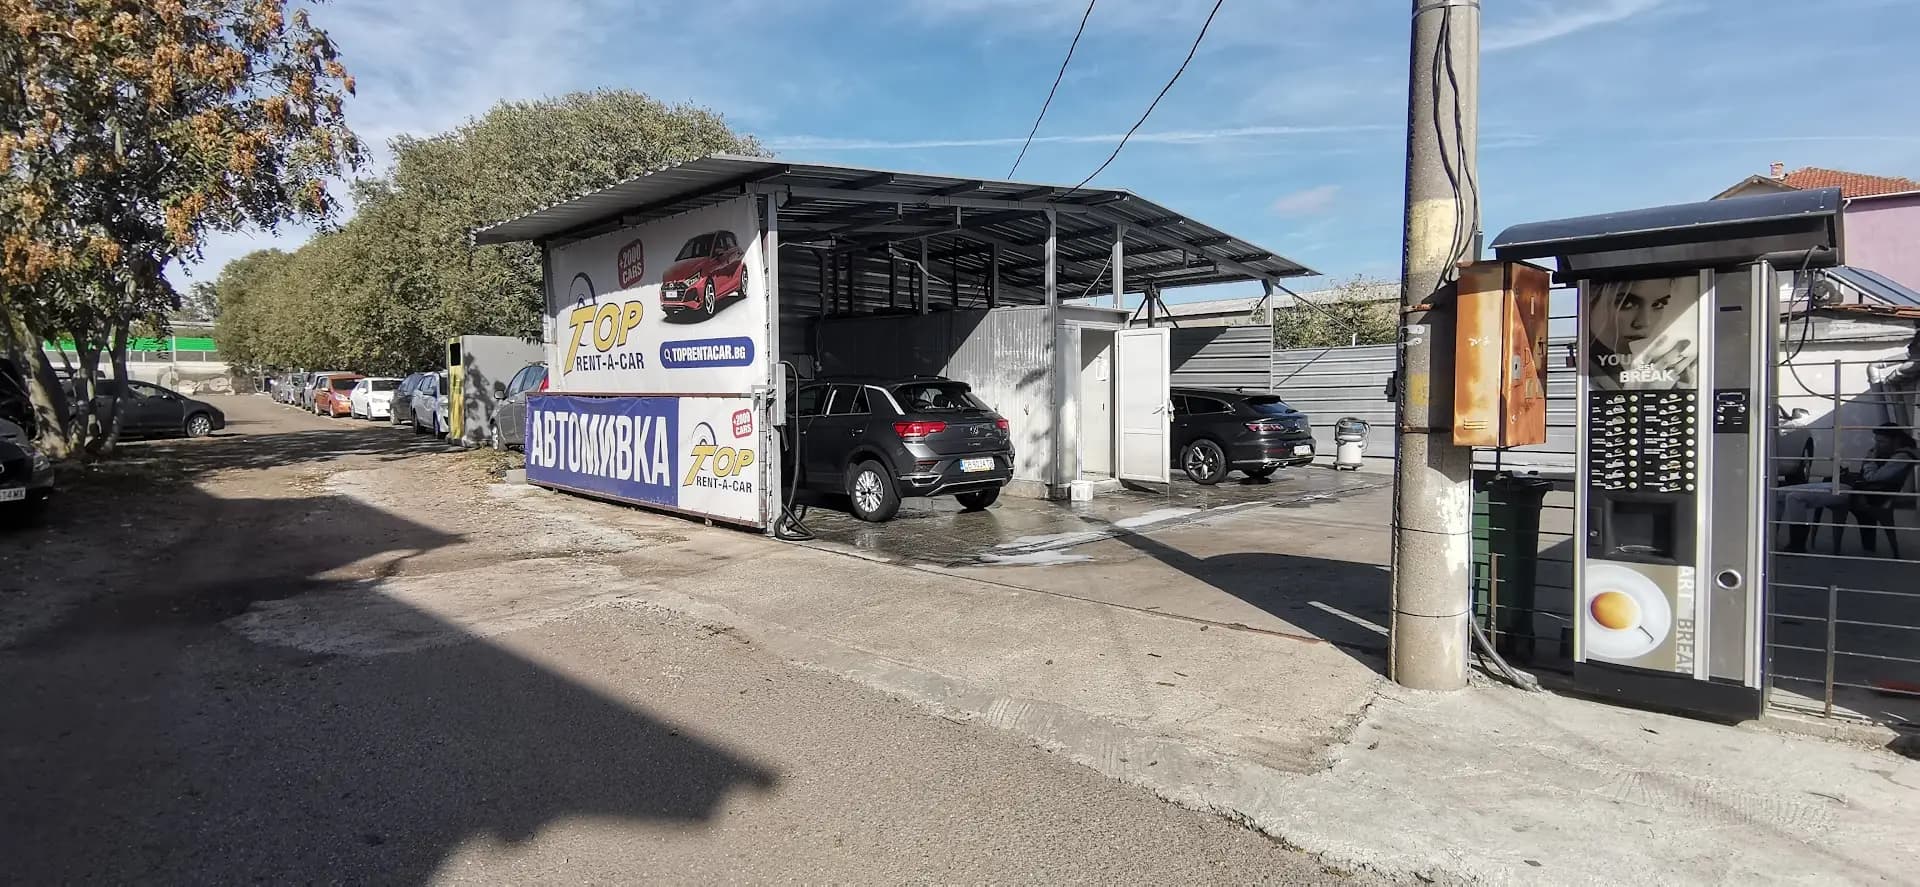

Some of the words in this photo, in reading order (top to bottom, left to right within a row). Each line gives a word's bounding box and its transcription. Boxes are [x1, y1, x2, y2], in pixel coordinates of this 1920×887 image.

[619, 243, 641, 269] +2000
[622, 261, 642, 284] CARS
[564, 300, 644, 376] TOP
[576, 352, 645, 372] RENT-A-CAR
[672, 344, 746, 362] TOPRENTACAR.BG
[1619, 369, 1674, 383] BREAK
[735, 424, 752, 436] CARS
[530, 410, 671, 487] АВТОМИВКА
[683, 444, 755, 487] TOP
[696, 475, 752, 494] RENT-A-CAR
[1678, 566, 1694, 602] ART
